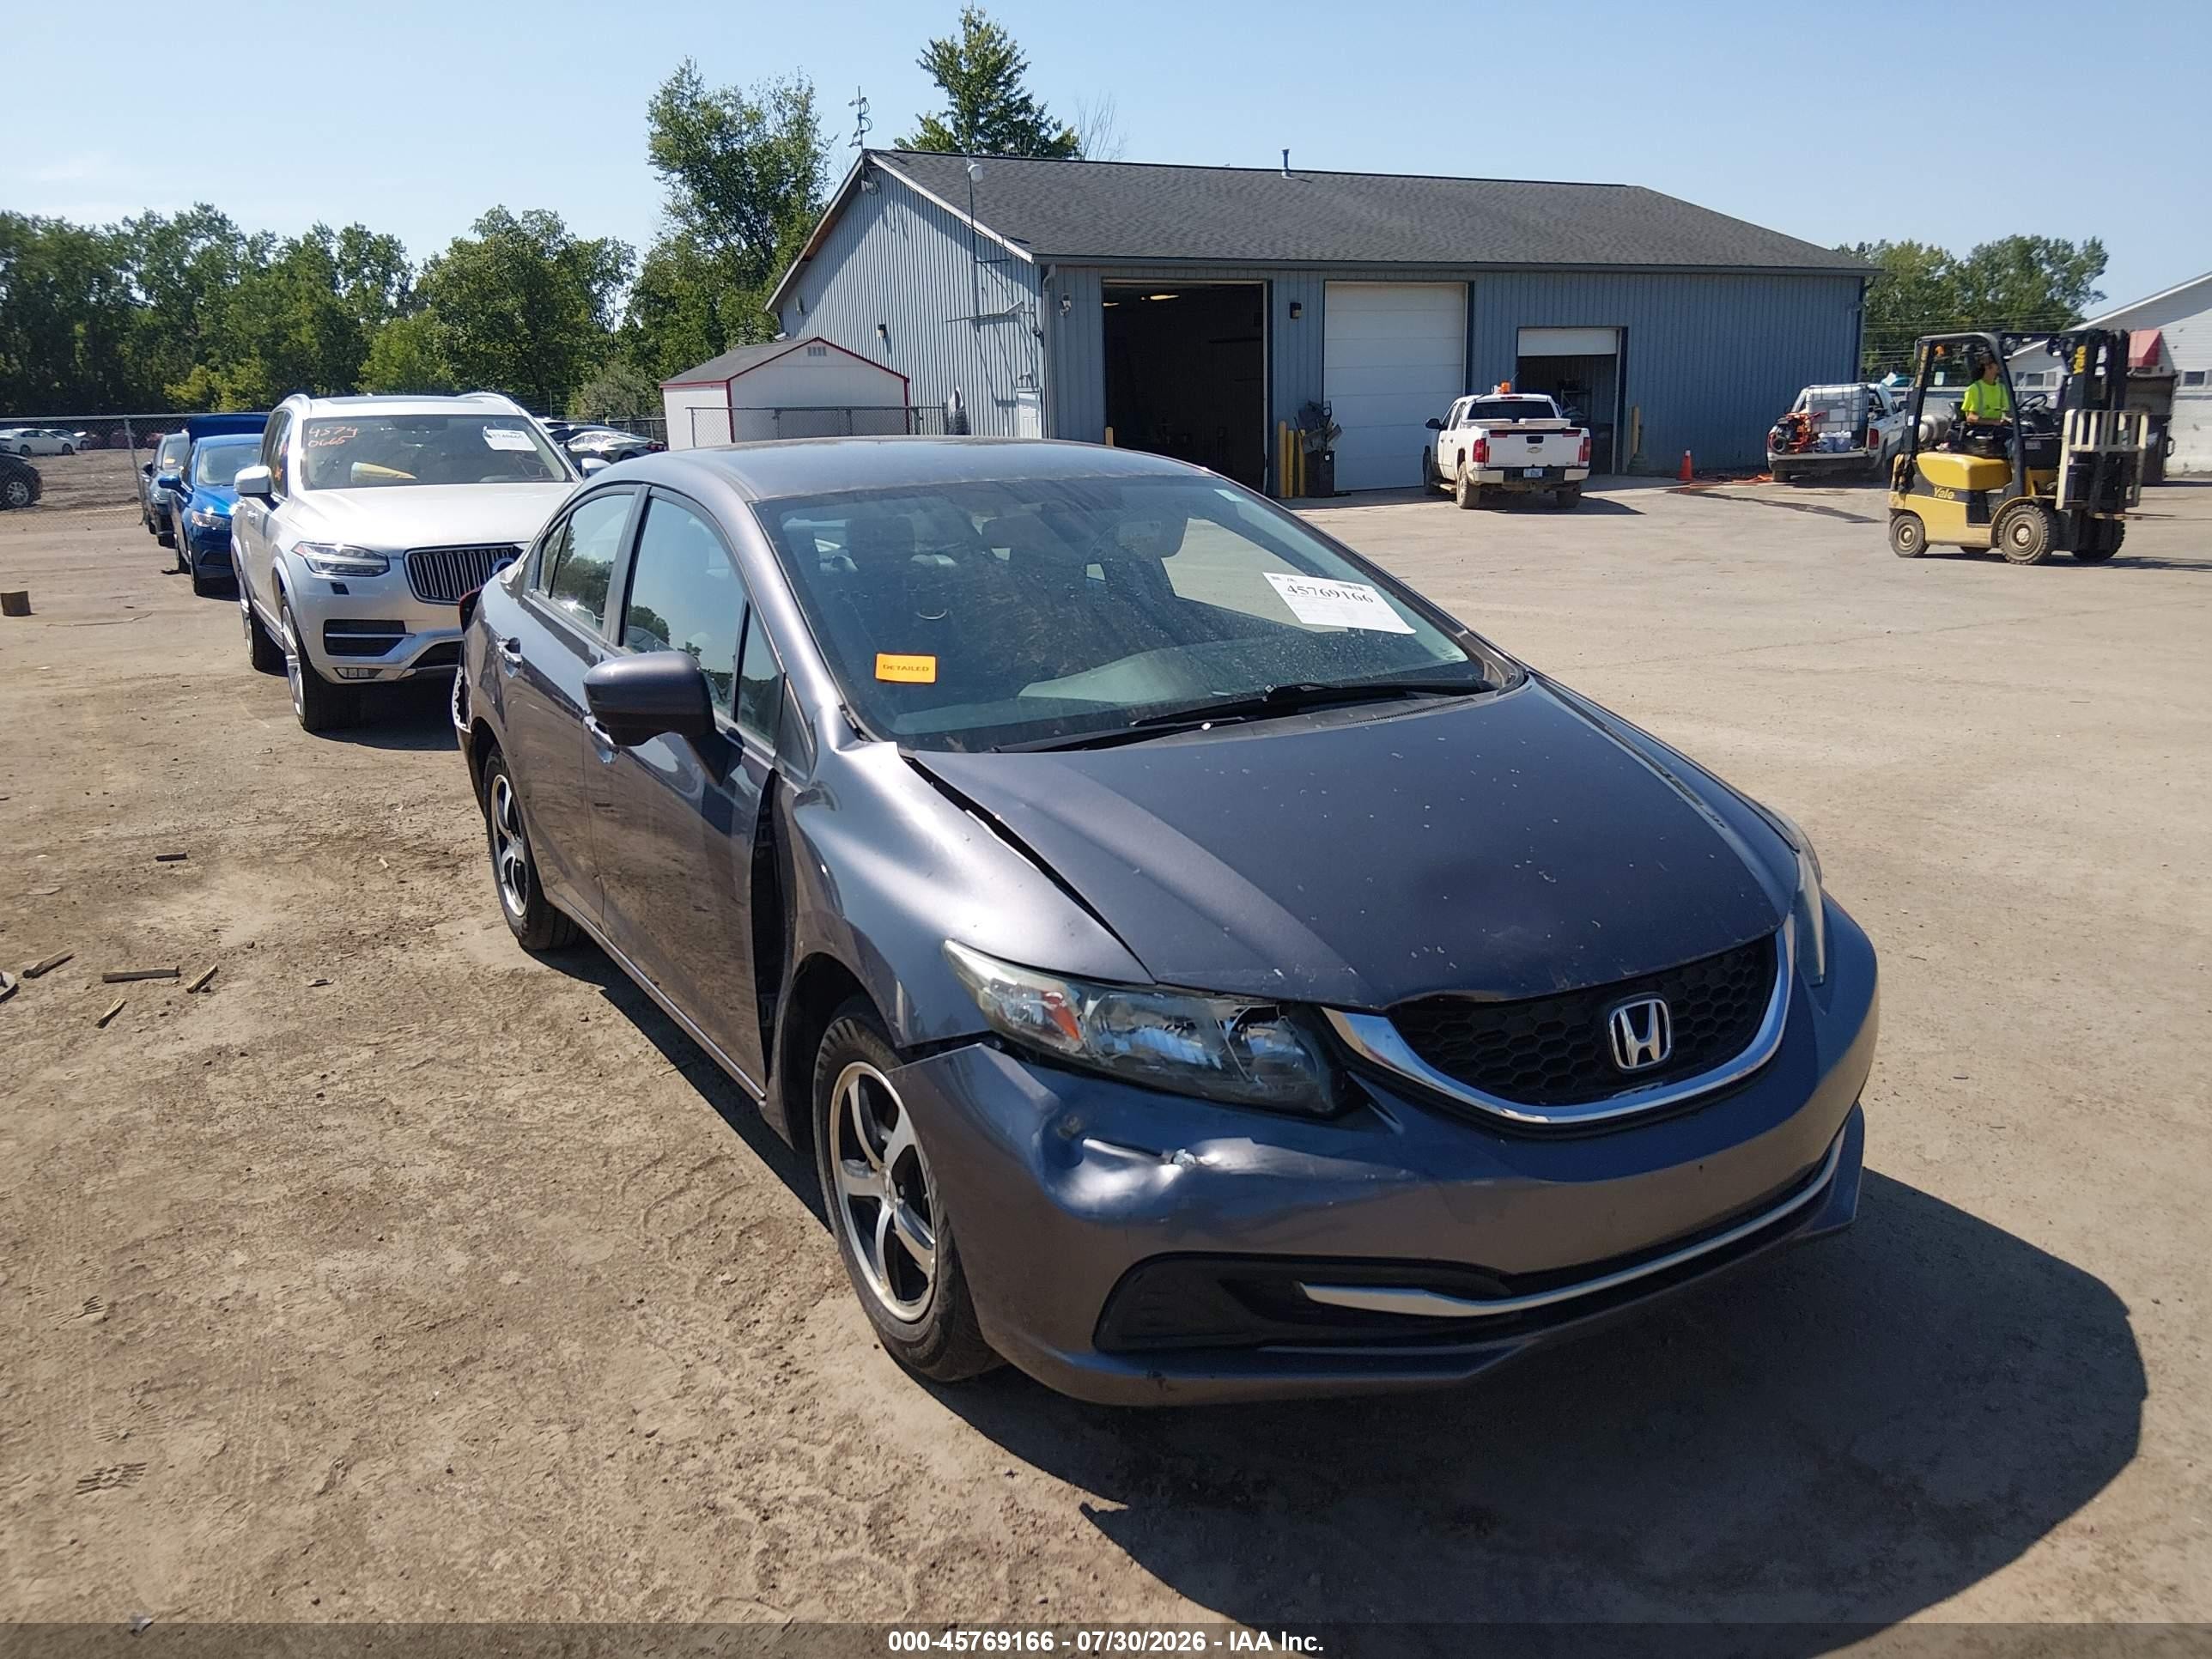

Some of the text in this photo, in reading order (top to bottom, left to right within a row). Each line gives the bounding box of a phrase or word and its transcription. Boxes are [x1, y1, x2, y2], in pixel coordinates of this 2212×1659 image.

[2072, 345, 2087, 374] Yale
[309, 426, 358, 437] 4574
[1934, 487, 1955, 500] Yale
[1286, 584, 1374, 603] 45769166
